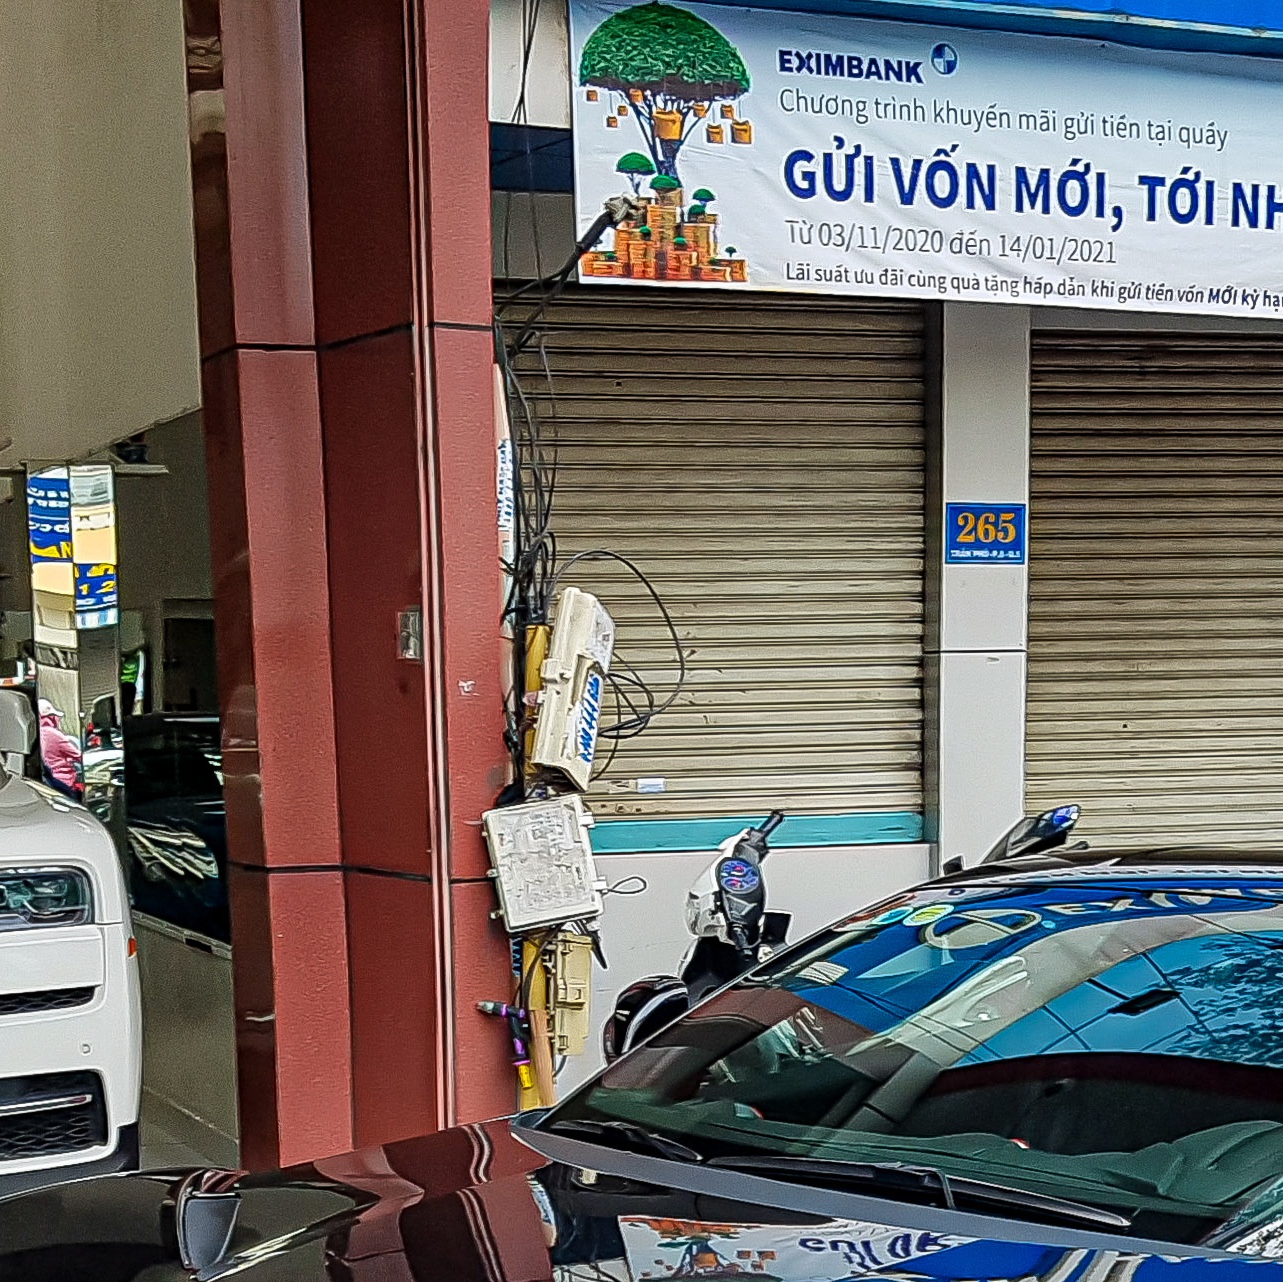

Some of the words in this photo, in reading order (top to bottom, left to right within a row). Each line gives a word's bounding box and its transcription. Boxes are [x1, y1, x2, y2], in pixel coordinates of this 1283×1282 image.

[778, 49, 924, 83] EXIMBANK
[779, 88, 869, 124] Chương
[875, 96, 926, 122] trình
[933, 98, 1011, 133] khuyến
[1018, 109, 1057, 132] mãi
[1063, 111, 1095, 140] gửi
[1148, 119, 1172, 146] tại
[782, 135, 875, 203] GỬI
[889, 144, 997, 211] VỐN
[1015, 157, 1124, 232] MỚI,
[1138, 166, 1215, 226] TỚI
[784, 219, 813, 245] Từ
[818, 222, 944, 254] 03/11/2020
[949, 229, 991, 256] đến
[999, 233, 1117, 265] 14/01/2021
[786, 262, 810, 281] Lãi
[814, 264, 850, 283] suất
[854, 268, 874, 284] ưu
[879, 267, 903, 286] đãi
[908, 269, 947, 294] cùng
[951, 273, 980, 295] quà
[985, 274, 1019, 298] tặng
[1023, 276, 1053, 299] hấp
[1091, 279, 1115, 298] khi
[1118, 281, 1142, 304] gửi
[1177, 284, 1204, 304] vốn
[1208, 285, 1238, 305] MỚI
[956, 511, 1016, 544] 265
